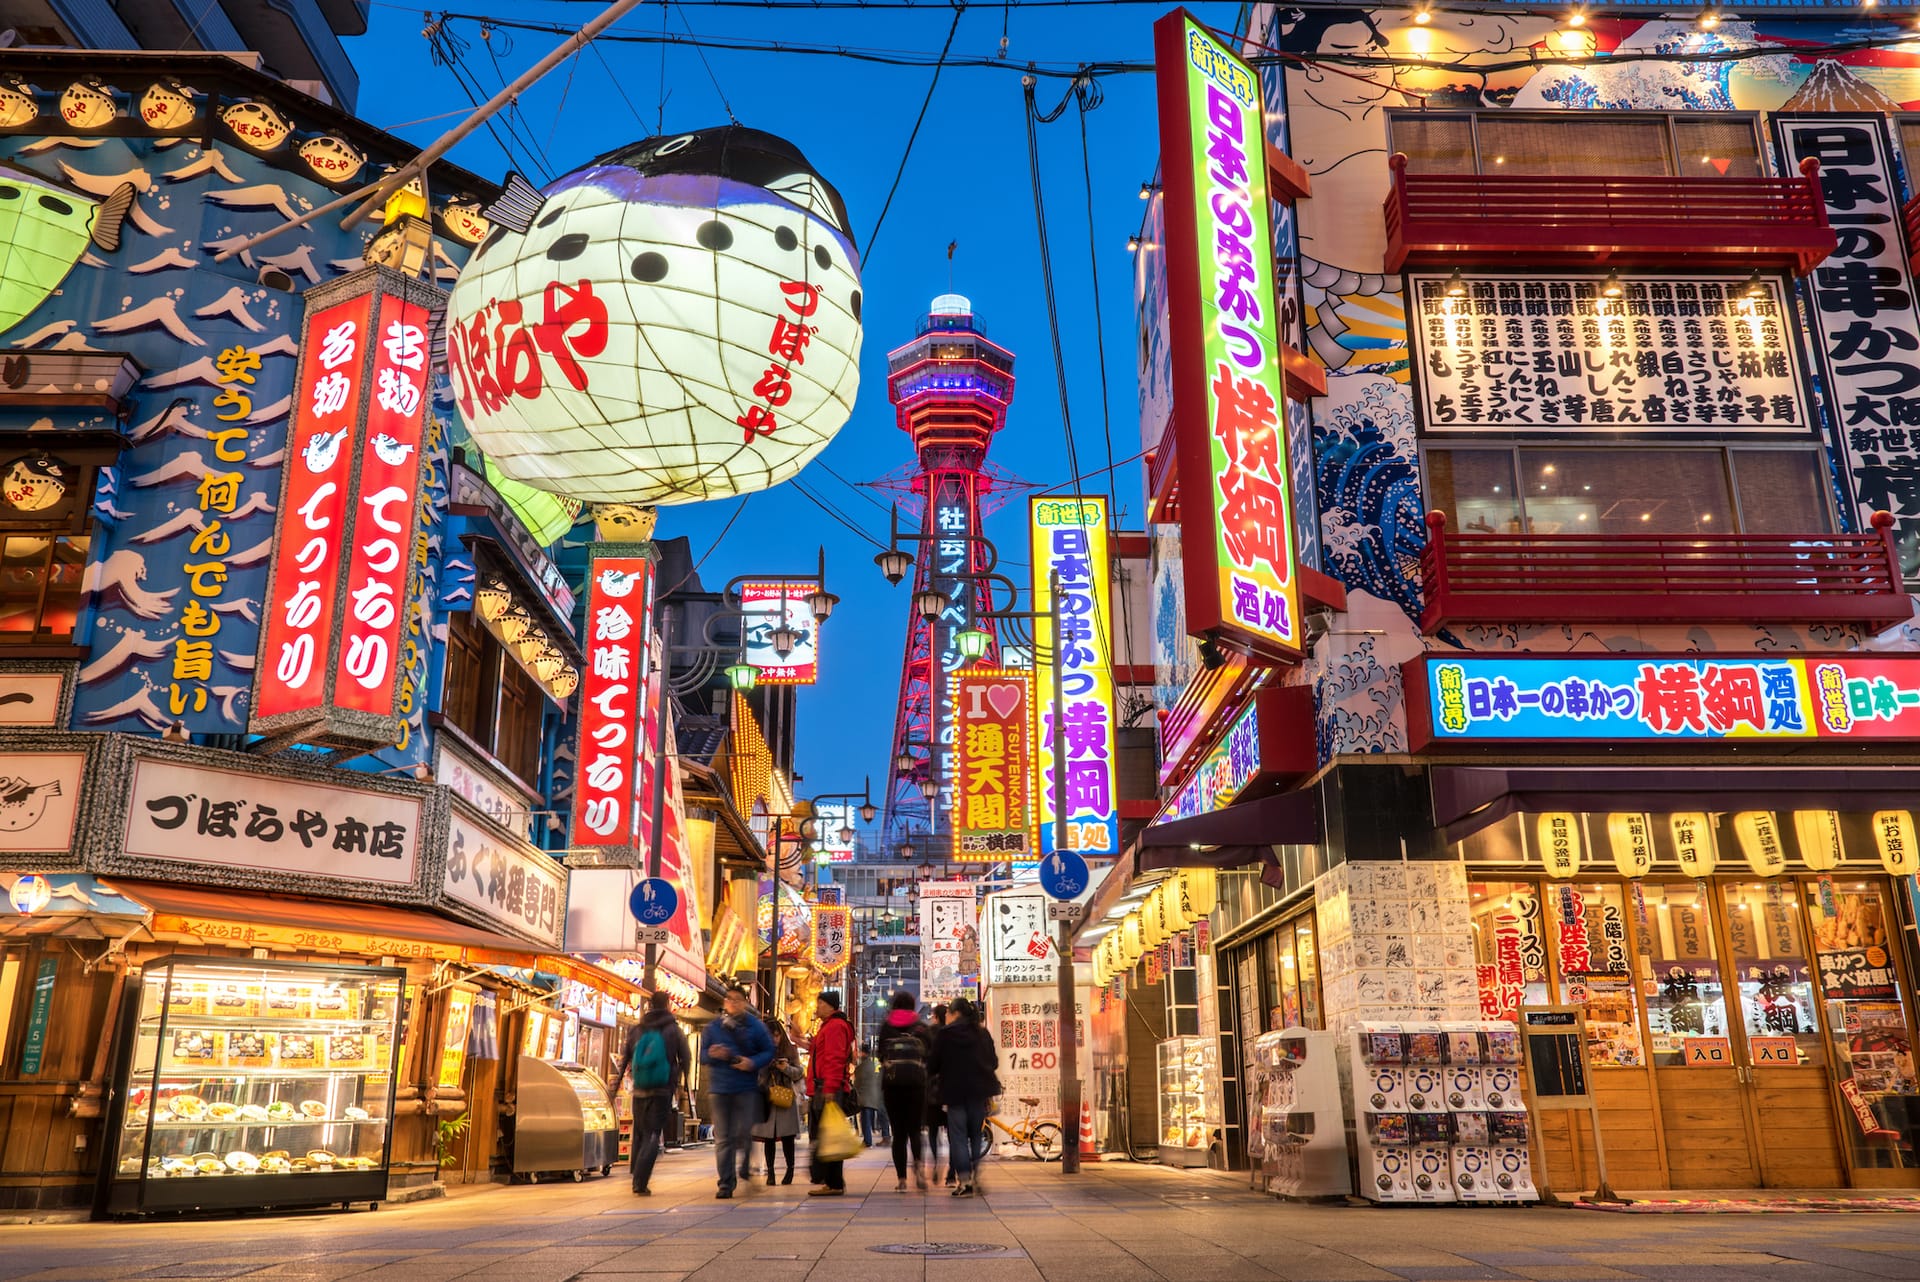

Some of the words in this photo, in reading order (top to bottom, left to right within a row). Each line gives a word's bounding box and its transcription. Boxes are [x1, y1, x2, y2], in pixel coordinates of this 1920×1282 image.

[1190, 31, 1253, 107] 新世界
[1207, 84, 1262, 367] 日本一の串かつ
[1792, 126, 1920, 396] 日本一の串かつ
[1421, 282, 1446, 316] 前頭
[1472, 282, 1498, 316] 前頭
[1497, 282, 1524, 316] 前頭
[1523, 282, 1550, 316] 前頭
[1549, 282, 1575, 316] 前頭
[1574, 282, 1600, 316] 前頭
[1624, 283, 1651, 317] 前頭
[1650, 283, 1676, 317] 前頭
[1700, 283, 1727, 317] 前頭
[311, 320, 357, 418] 名物
[376, 320, 427, 417] 名物
[448, 279, 609, 420] づぼらや
[737, 281, 823, 444] づぼらや
[1675, 283, 1701, 317] 前頭
[1688, 350, 1718, 423] さつま芋
[1725, 283, 1750, 317] 前頭
[1738, 350, 1769, 423] 茄子
[1429, 350, 1457, 423] もち
[1456, 350, 1485, 422] うずら玉子
[1481, 350, 1511, 422] 紅しょうが
[1505, 351, 1534, 423] にんにく
[1532, 351, 1561, 423] 玉ねぎ
[1558, 351, 1588, 423] 山芋
[1584, 350, 1616, 422] しし唐
[1609, 350, 1642, 422] れんこん
[1634, 350, 1666, 423] 銀杏
[1661, 350, 1691, 423] 白ねぎ
[1712, 350, 1744, 423] じゃが芋
[1763, 350, 1796, 423] 椎茸
[1213, 363, 1289, 583] 横綱
[170, 344, 262, 716] 安うて何んでも旨い
[1038, 503, 1100, 526] 新世界
[277, 482, 337, 689] てっちり
[345, 486, 409, 690] てっちり
[1052, 529, 1095, 697] 日本一の串かつ
[1234, 577, 1290, 636] 酒処
[584, 604, 633, 836] 珍味てっちり
[966, 685, 988, 719] I
[1441, 666, 1466, 730] 新世界
[1468, 680, 1634, 720] 日本一の串かつ
[1637, 665, 1766, 733] 横綱
[1763, 667, 1803, 731] 酒処
[1820, 667, 1849, 730] 新世界
[1850, 680, 1920, 721] 日本一
[965, 722, 1006, 830] 通天閣
[1007, 722, 1023, 829] TSUTENKAKU
[1044, 701, 1110, 818] 横綱
[146, 793, 407, 860] づぼらや本店
[986, 833, 1025, 852] 横綱
[1552, 818, 1570, 867] 自慢の逸品
[1630, 825, 1646, 866] 握り盛り
[1678, 829, 1697, 863] 寿司
[1885, 825, 1904, 864] お造り
[447, 828, 557, 935] ふぐ料理専門
[179, 921, 270, 941] ふぐなら日本一
[293, 933, 342, 949] づぼらや
[366, 939, 445, 958] ふぐなら日本一
[829, 914, 845, 953] 串かつ
[1496, 914, 1525, 1012] 二度漬け
[1518, 899, 1543, 967] ソースの
[1558, 892, 1592, 975] お座敷
[1682, 909, 1699, 955] 白ねぎ
[1820, 953, 1867, 971] 串かつ
[1476, 965, 1501, 1021] 御免
[1663, 972, 1704, 1035] 横綱
[1759, 973, 1800, 1034] 横綱
[1694, 1048, 1723, 1061] 入口
[1760, 1048, 1789, 1061] 入口
